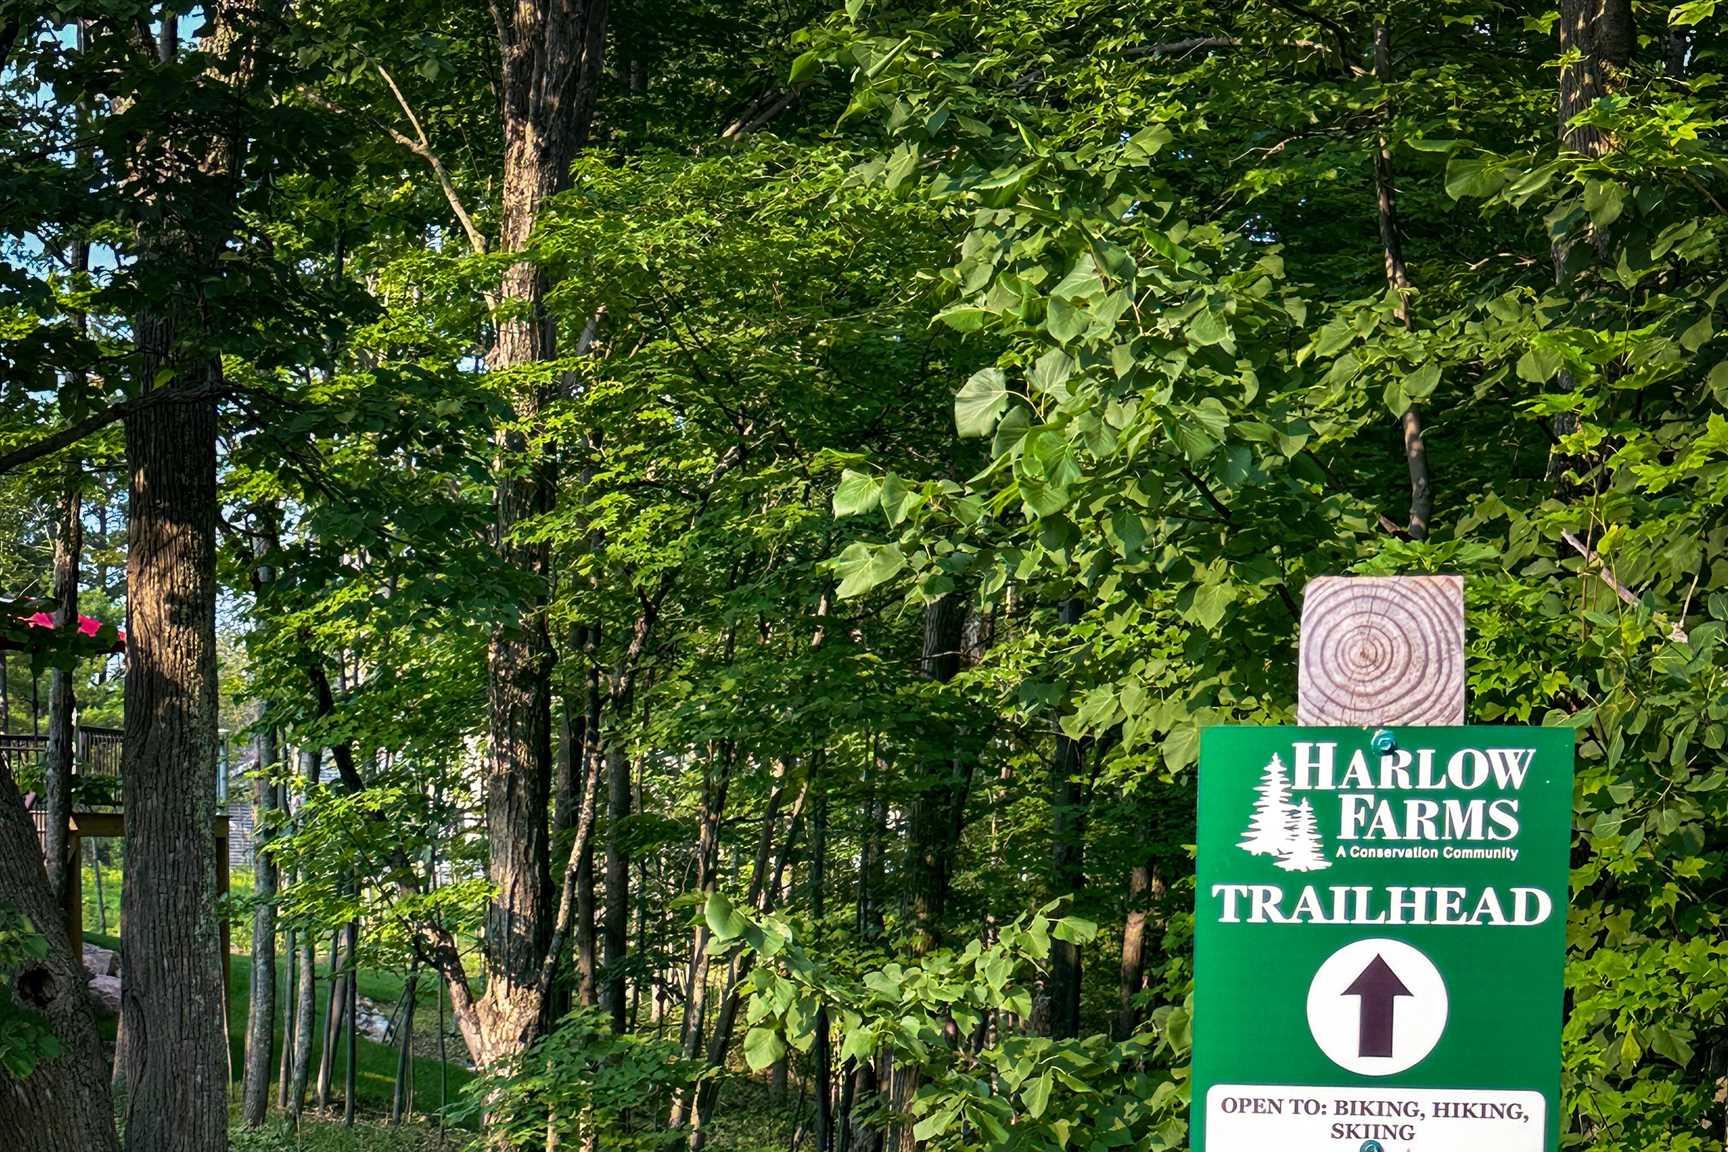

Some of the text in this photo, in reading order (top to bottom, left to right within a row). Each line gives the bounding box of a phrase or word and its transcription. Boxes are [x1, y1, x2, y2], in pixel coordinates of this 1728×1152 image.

[1291, 742, 1536, 790] HARLOW
[1336, 793, 1519, 841] FARMS
[1336, 845, 1519, 862] A Conservation Community
[1212, 883, 1552, 927] TRAILHEAD
[1221, 1097, 1529, 1123] OPEN TO: BIKING, HIKING,
[1331, 1123, 1416, 1141] SKIING
